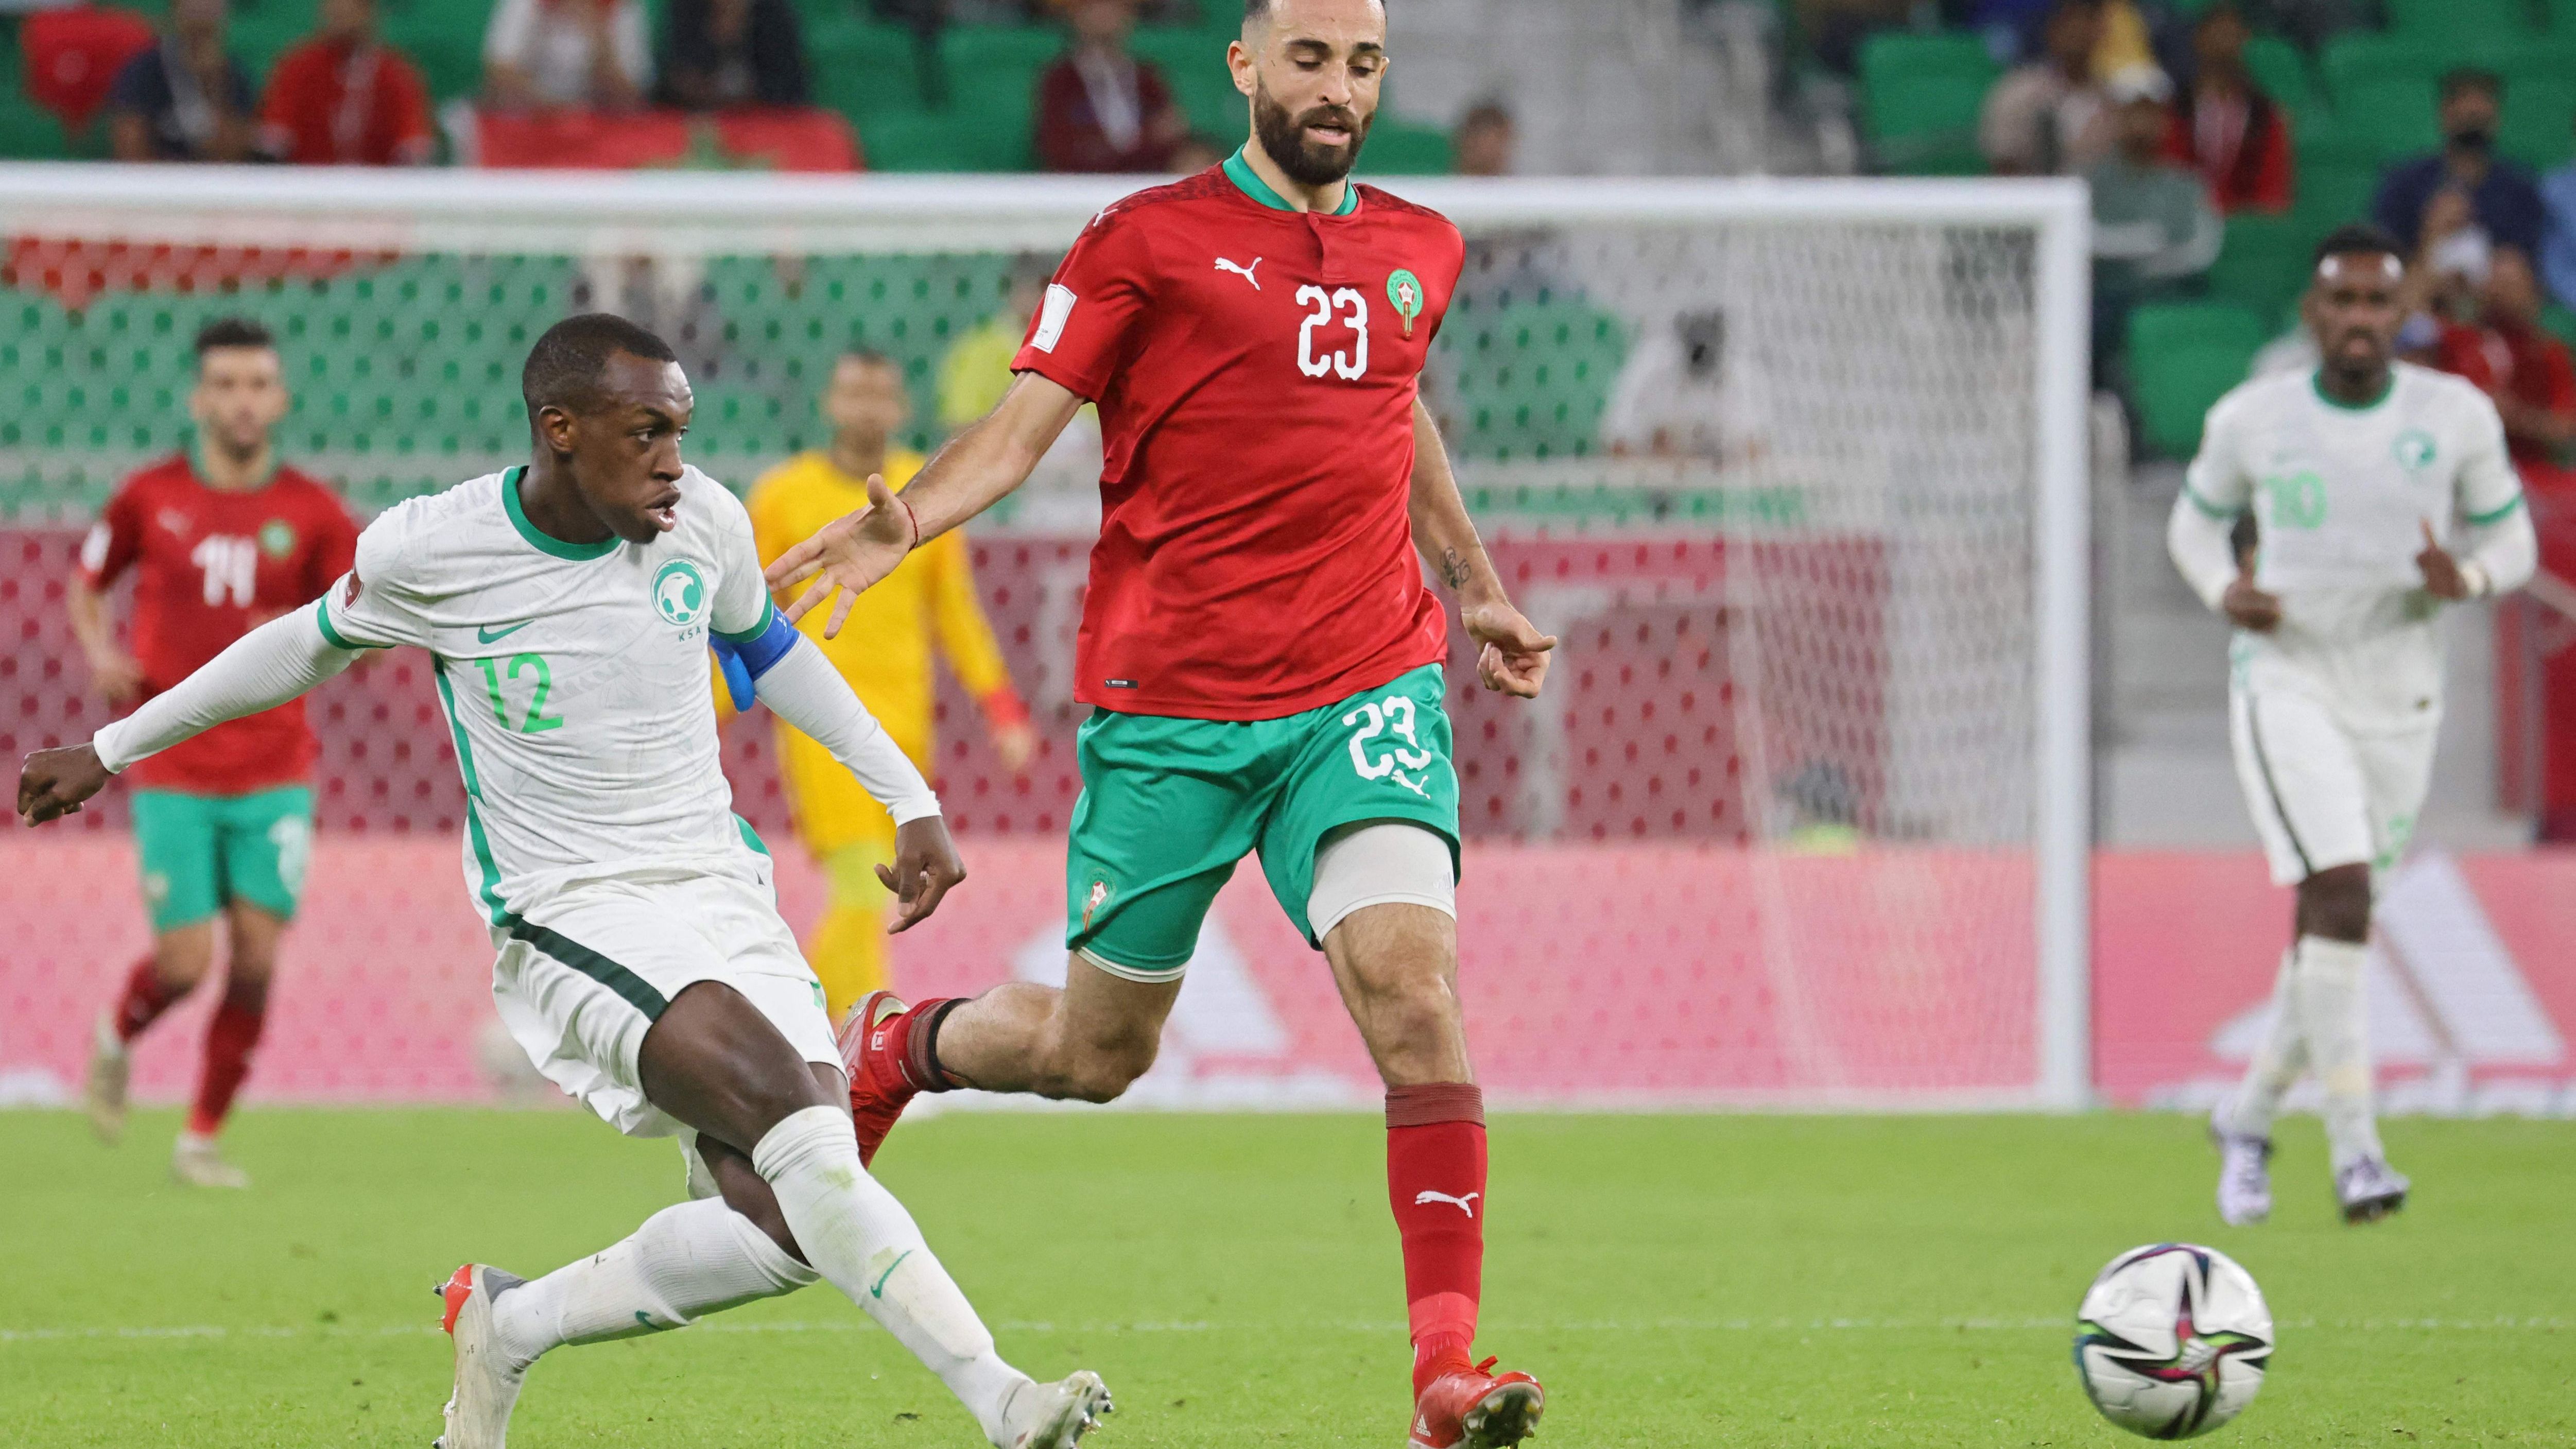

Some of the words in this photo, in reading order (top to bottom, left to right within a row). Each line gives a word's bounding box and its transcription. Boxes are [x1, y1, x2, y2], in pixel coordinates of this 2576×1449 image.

[1295, 285, 1368, 382] 23
[2266, 469, 2327, 530] 10
[679, 626, 701, 642] KSA
[474, 652, 564, 734] 12
[1342, 695, 1432, 780] 23
